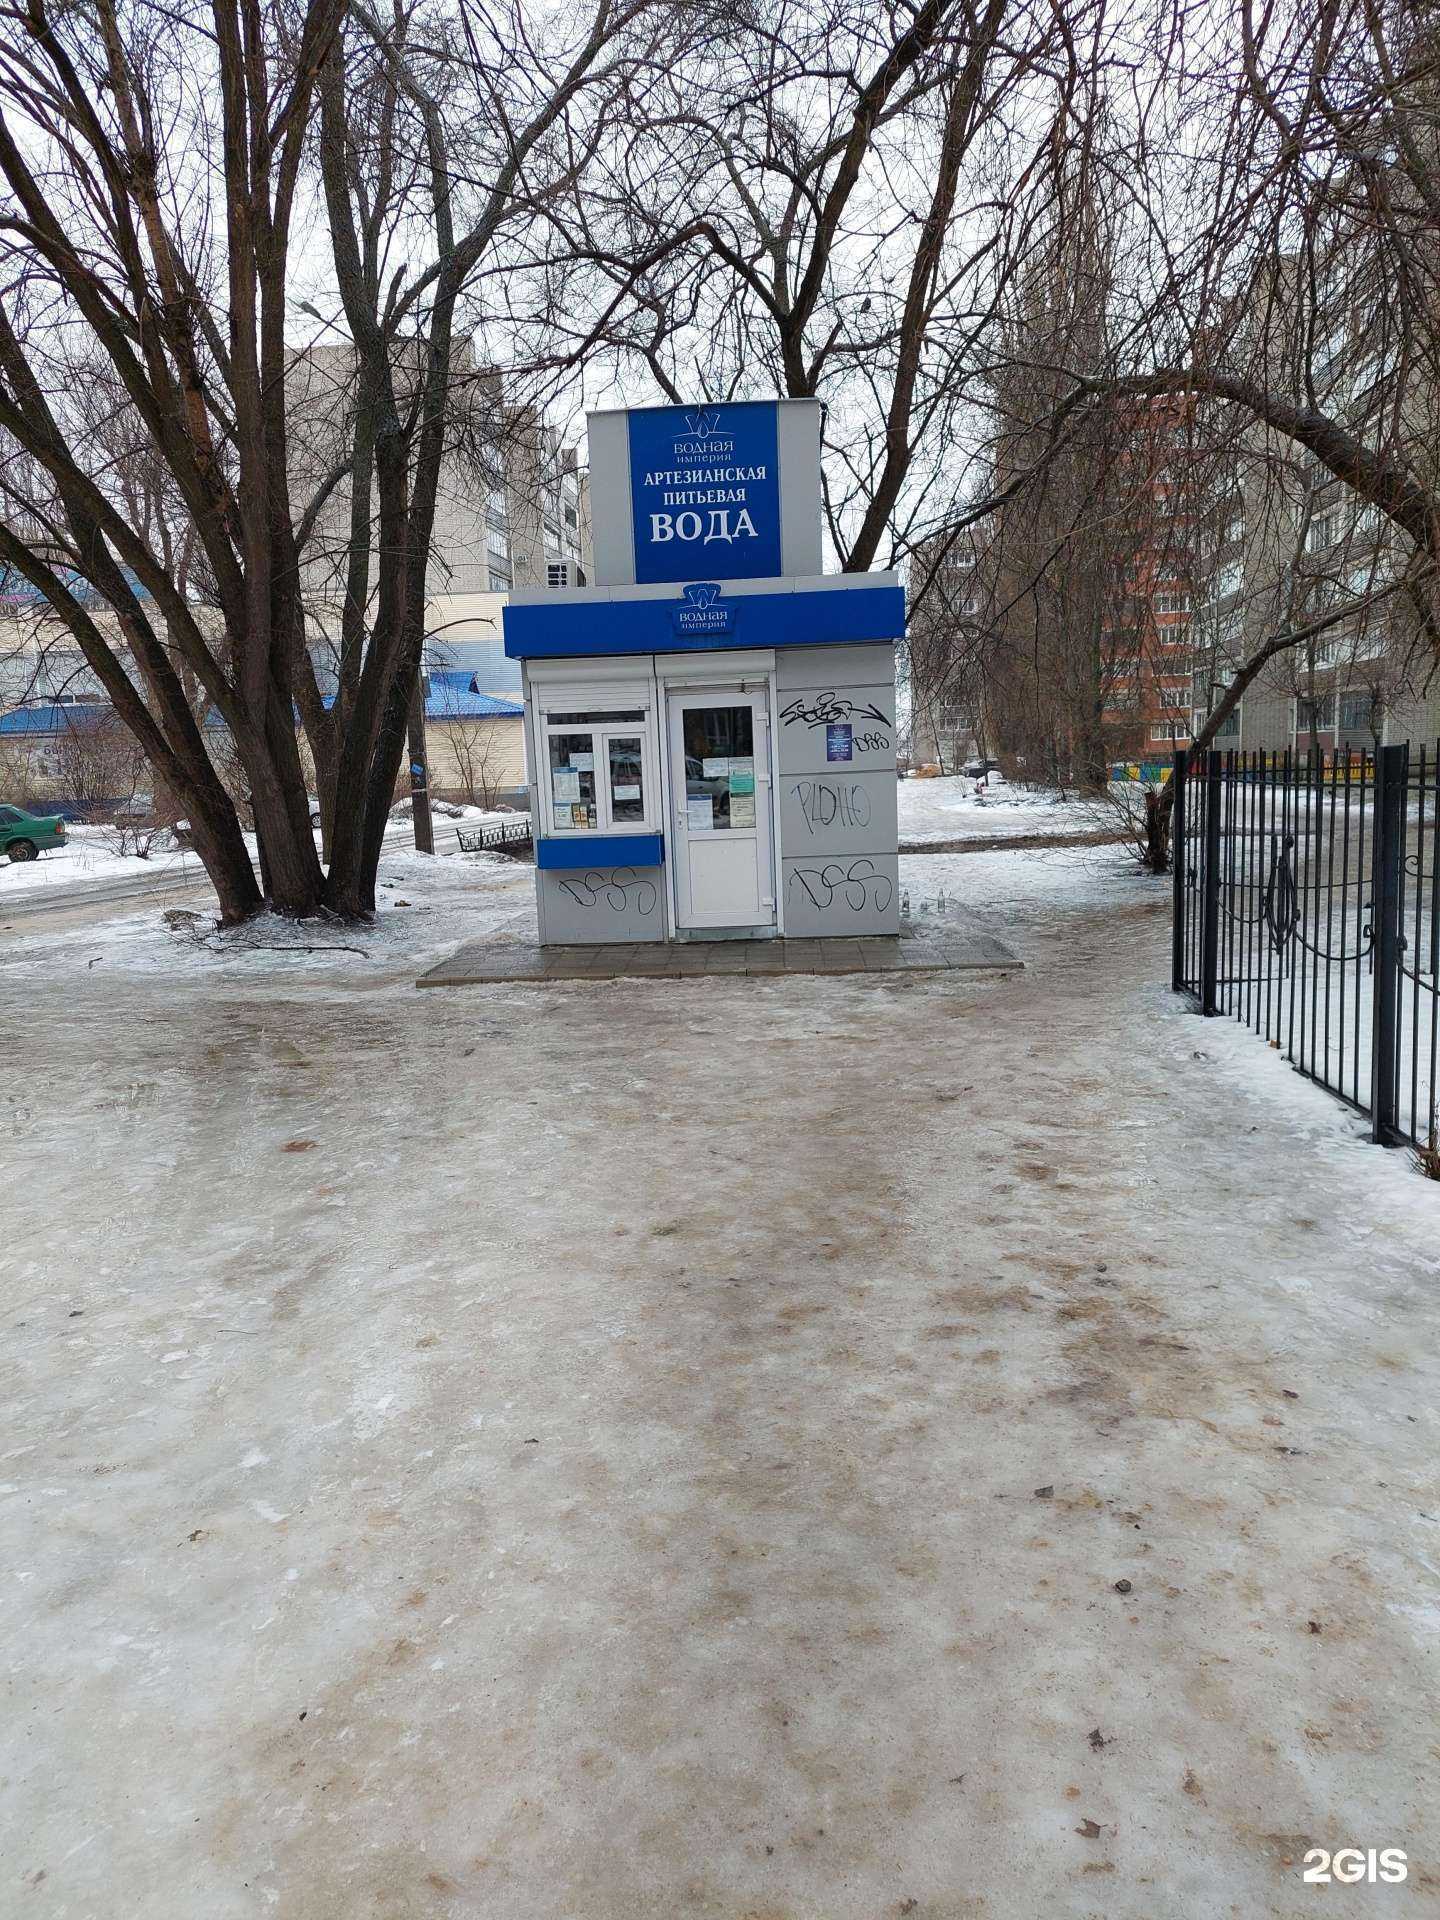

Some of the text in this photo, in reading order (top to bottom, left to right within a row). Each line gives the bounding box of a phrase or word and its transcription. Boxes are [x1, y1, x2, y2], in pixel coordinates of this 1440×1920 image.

[644, 466, 767, 486] АРТЕЗИАНСКАЯ
[663, 488, 746, 506] ПИТЬЕВАЯ
[649, 508, 759, 546] ВОДА
